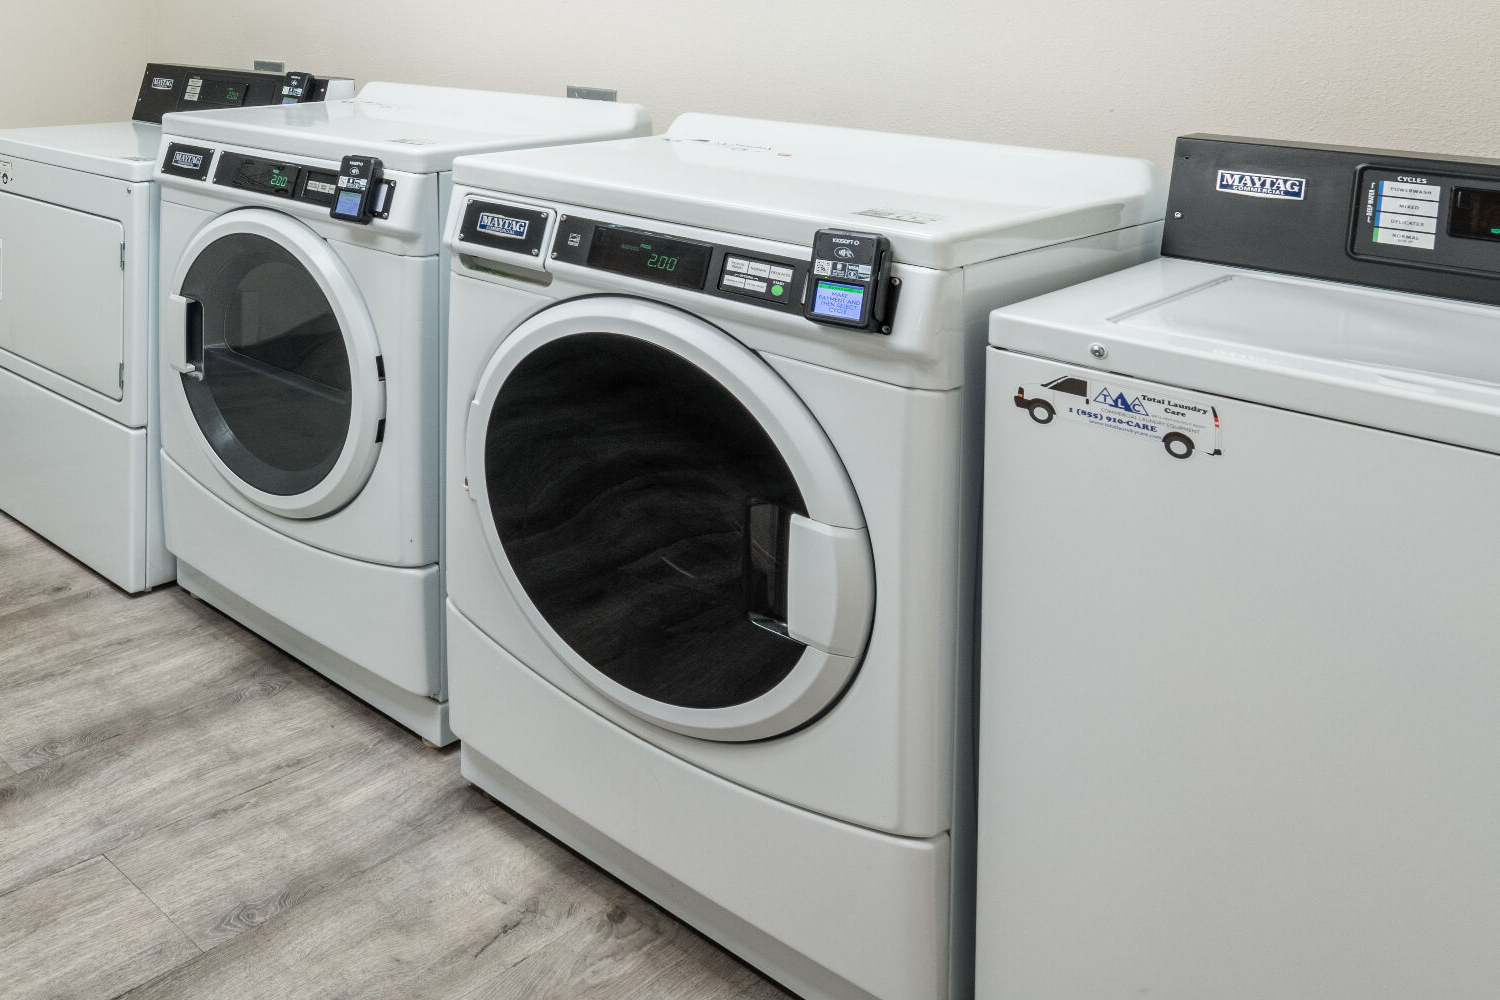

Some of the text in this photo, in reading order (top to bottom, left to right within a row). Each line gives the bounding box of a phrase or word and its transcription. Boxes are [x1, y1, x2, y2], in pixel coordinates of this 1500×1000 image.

[153, 78, 173, 88] MAYTAG
[175, 152, 202, 164] MAYTAG
[1222, 173, 1300, 192] MAYTAG
[1397, 176, 1428, 184] CYCLES
[1233, 186, 1285, 195] COMMERCIAL
[481, 215, 525, 232] MAYTAG
[1390, 219, 1426, 227] DELICATES
[647, 254, 678, 271] 2.00
[819, 295, 845, 304] PAYMENT
[1141, 394, 1208, 414] Total Laundry
[1164, 408, 1186, 417] Care
[1076, 408, 1103, 421] (855)
[1106, 416, 1158, 432] 910-CARE
[1101, 407, 1138, 420] COMMERCIAL
[1138, 414, 1166, 427] LAUNDRY
[1166, 422, 1201, 434] EQUIPMENT
